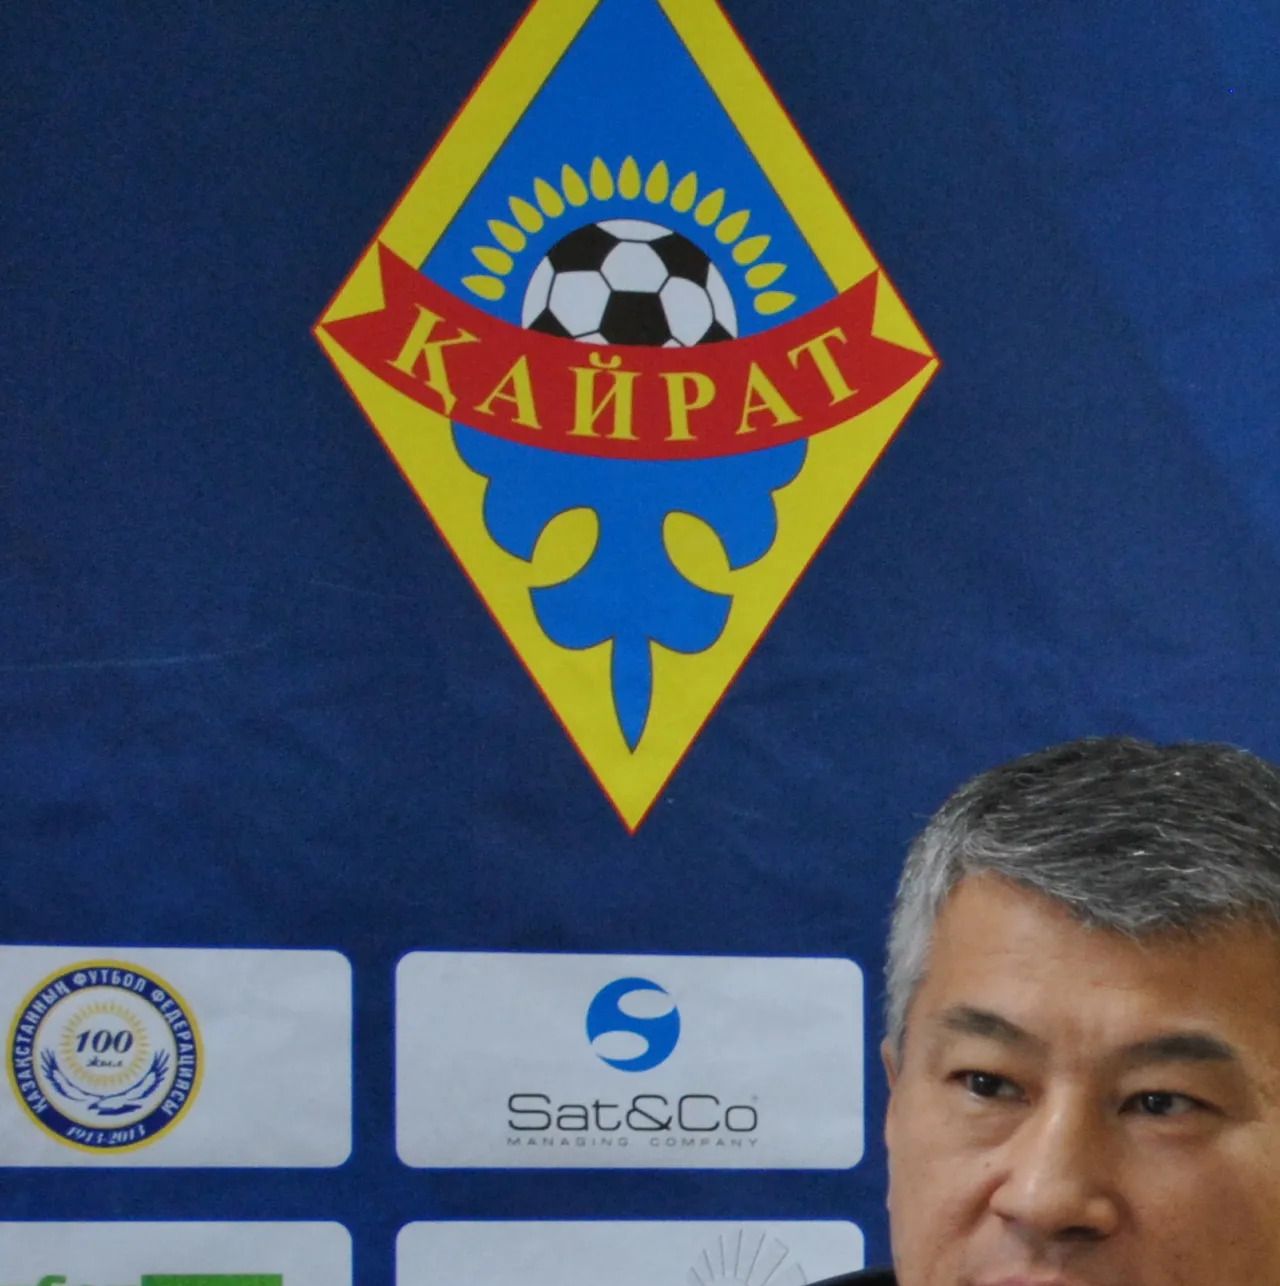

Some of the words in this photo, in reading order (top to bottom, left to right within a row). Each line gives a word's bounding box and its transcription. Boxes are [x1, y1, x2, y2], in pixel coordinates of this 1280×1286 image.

[386, 303, 860, 441] ҚАЙРАТ
[73, 969, 147, 992] ФУТБОЛ
[152, 988, 197, 1117] ФЕДЕРАЦИЯСЫ
[76, 1029, 134, 1054] 100
[508, 1093, 758, 1132] Sat&Co
[507, 1137, 629, 1147] MANAGING
[649, 1137, 759, 1148] COMPANY
